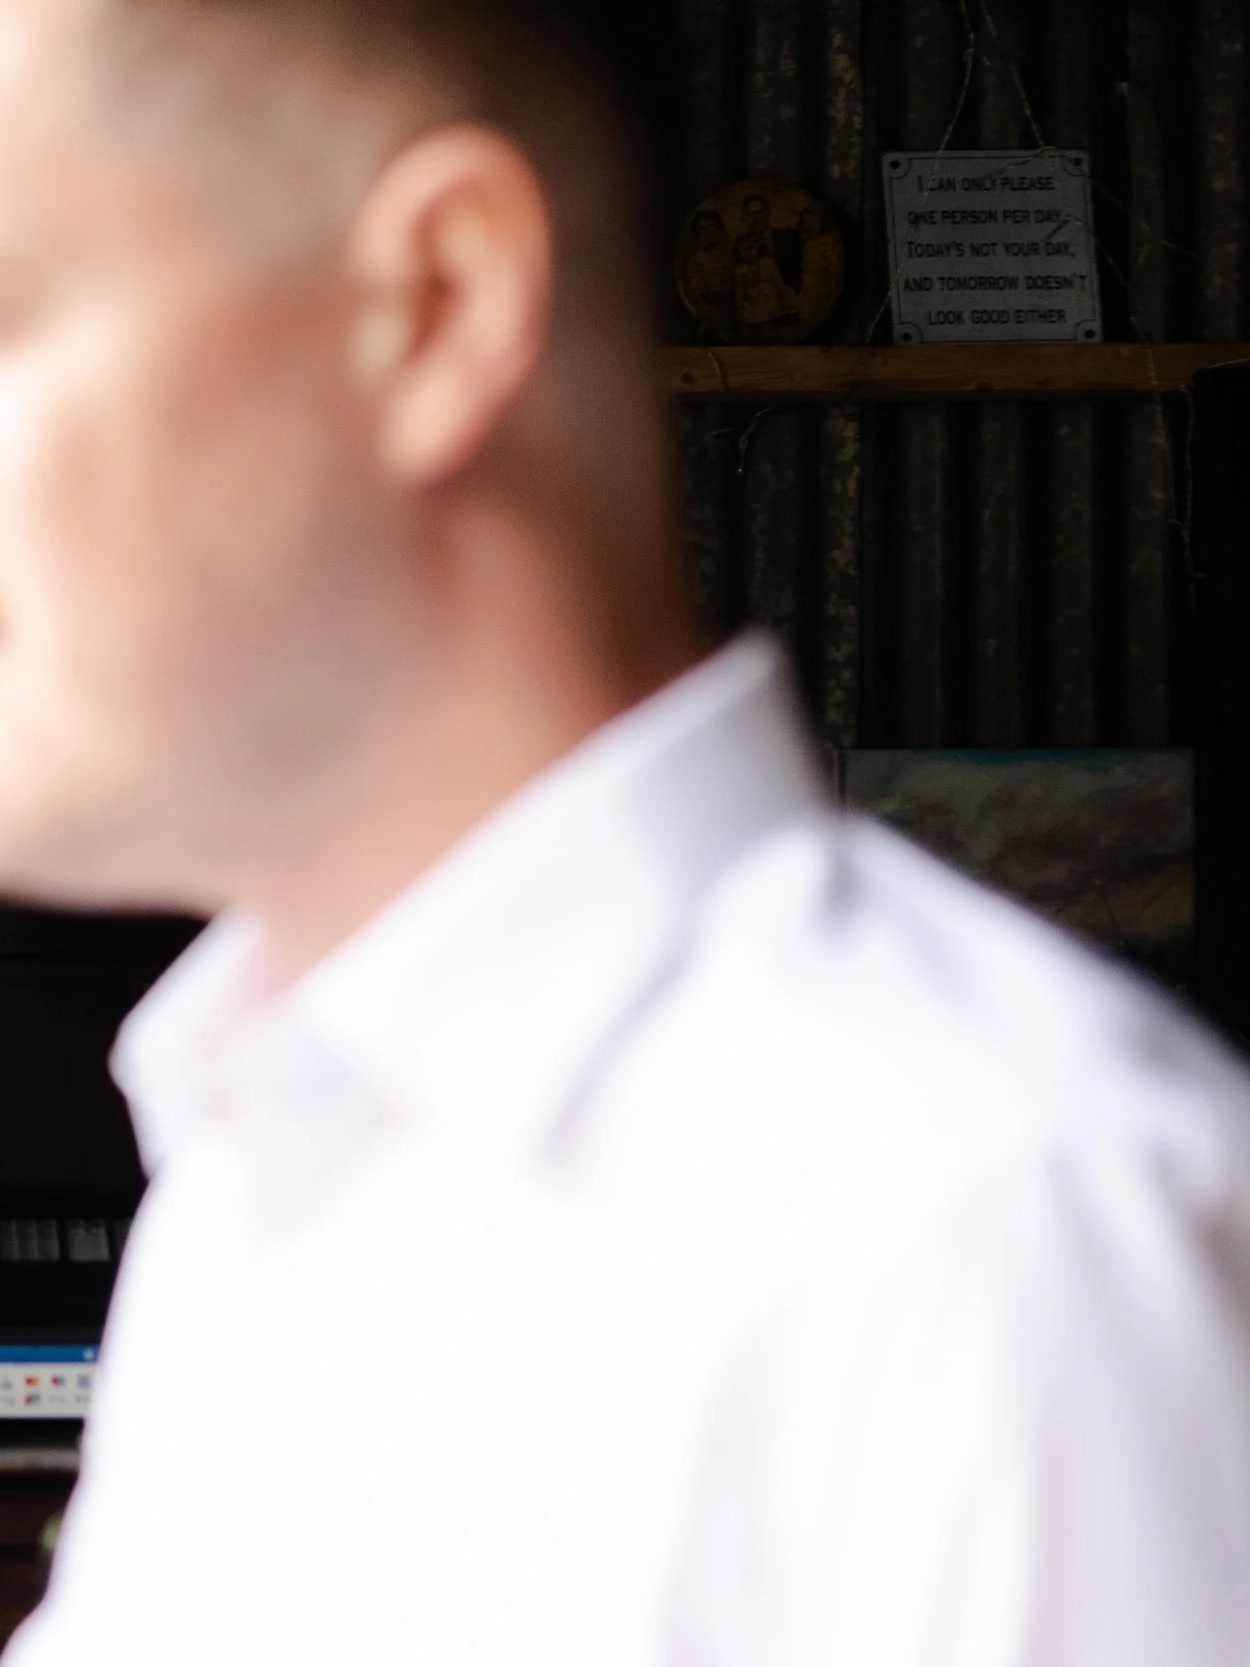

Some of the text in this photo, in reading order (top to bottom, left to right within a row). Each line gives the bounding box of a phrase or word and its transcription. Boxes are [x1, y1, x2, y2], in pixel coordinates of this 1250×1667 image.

[917, 175, 1055, 192] I CAN ONLY PLEASE
[908, 210, 938, 225] ONE
[942, 210, 998, 224] PERSON
[1003, 209, 1030, 224] PER
[907, 241, 965, 258] TODAY'S
[970, 242, 997, 257] NOT
[1003, 242, 1040, 257] YOUR
[903, 273, 1087, 292] AND TOMORROW DOESN'T
[928, 308, 1066, 325] LOOK GOOD EITHER
